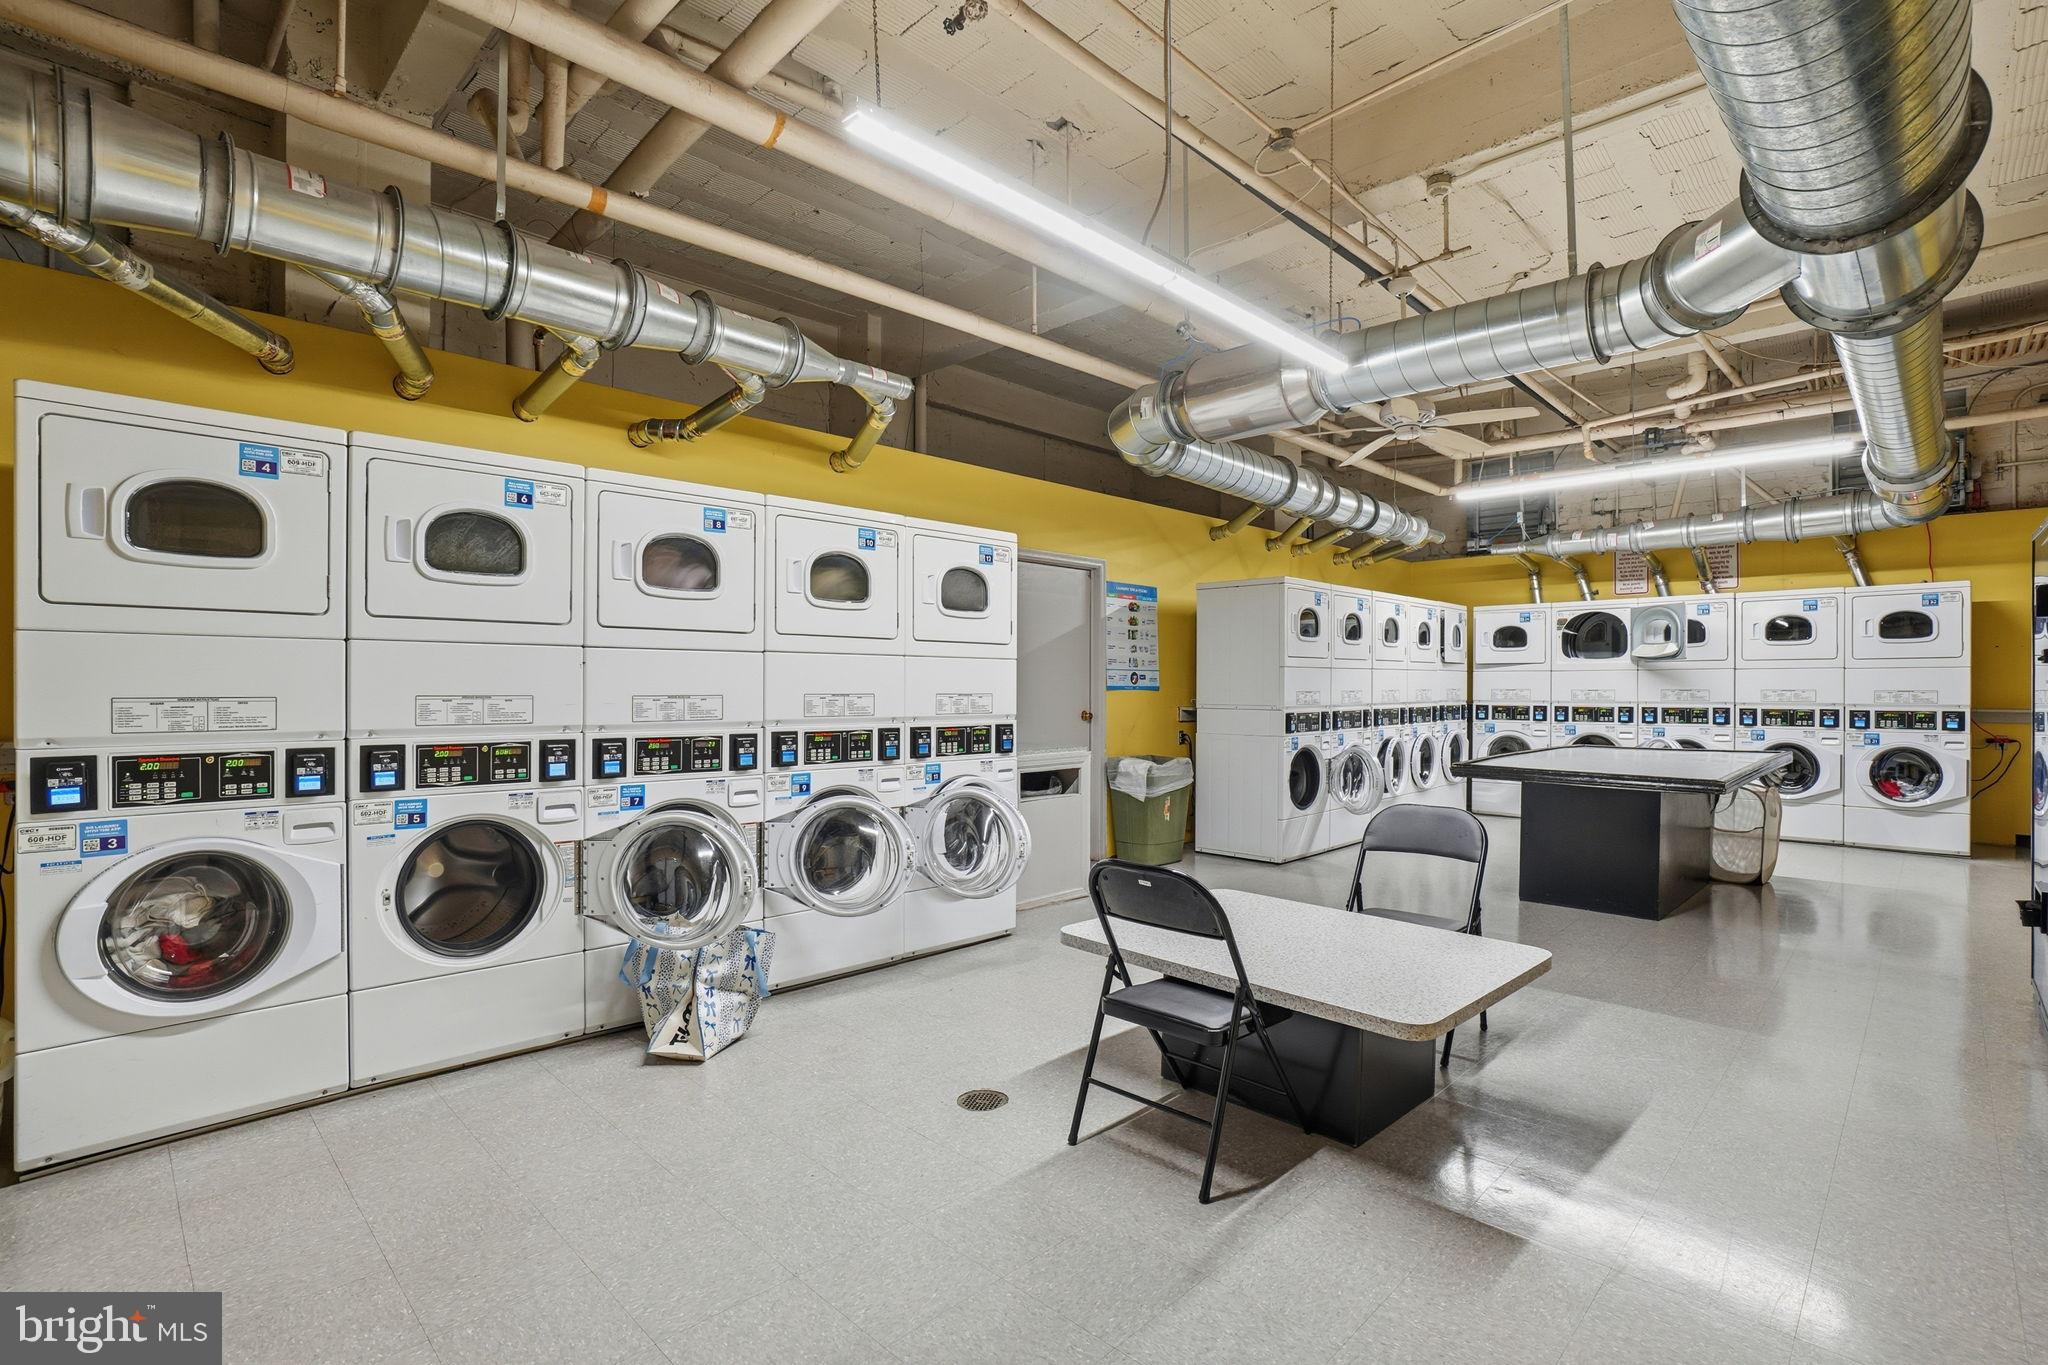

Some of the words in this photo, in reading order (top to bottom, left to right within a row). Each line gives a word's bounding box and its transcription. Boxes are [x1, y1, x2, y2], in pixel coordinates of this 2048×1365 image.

[261, 462, 271, 473] 4
[521, 494, 528, 503] 6
[715, 521, 722, 529] 8
[801, 784, 807, 792] 9
[633, 797, 640, 806] 7
[412, 814, 420, 823] 5
[27, 834, 67, 844] 608-HDF
[107, 838, 118, 849] 3
